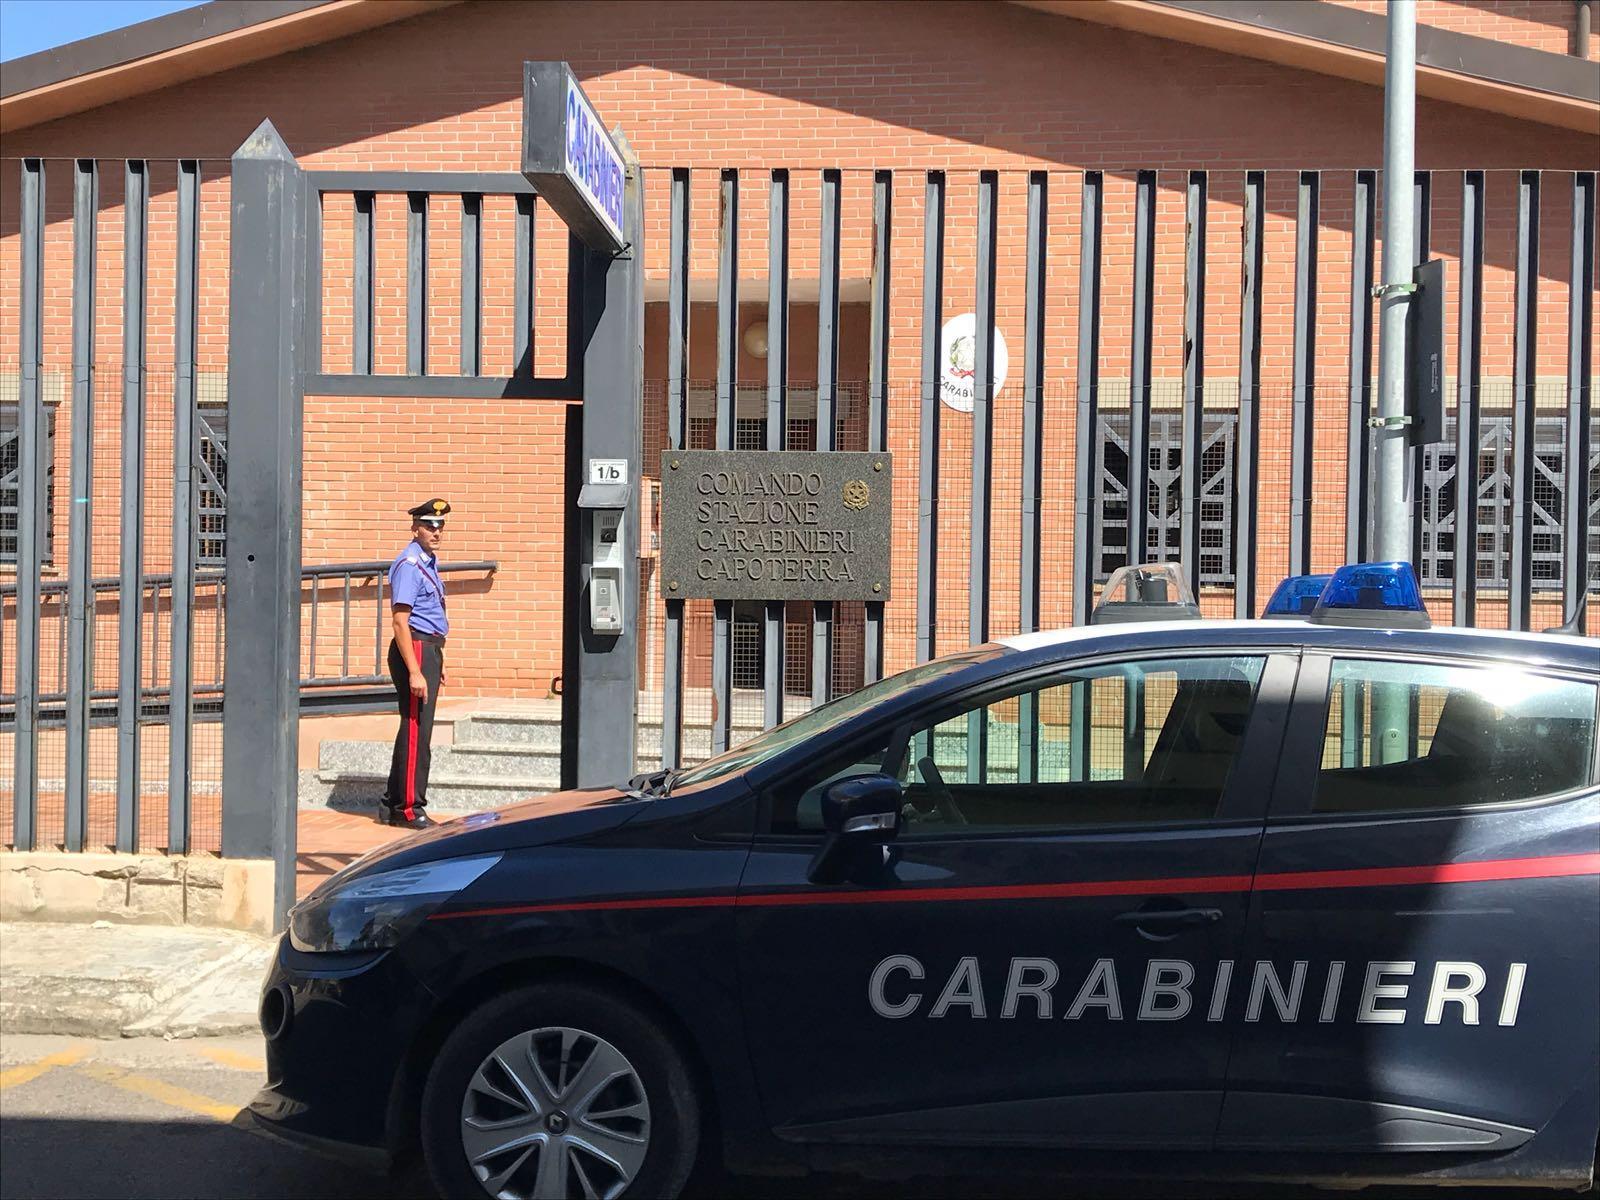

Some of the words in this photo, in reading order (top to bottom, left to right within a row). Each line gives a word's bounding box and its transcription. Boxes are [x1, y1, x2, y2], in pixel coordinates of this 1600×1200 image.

[598, 466, 620, 479] 1/b
[697, 472, 823, 496] COMANDO
[697, 501, 819, 525] STAZIONE
[697, 529, 854, 554] CARABINIERI
[697, 558, 854, 581] CAPOTERRA
[868, 954, 1527, 1027] CARABINIERI
